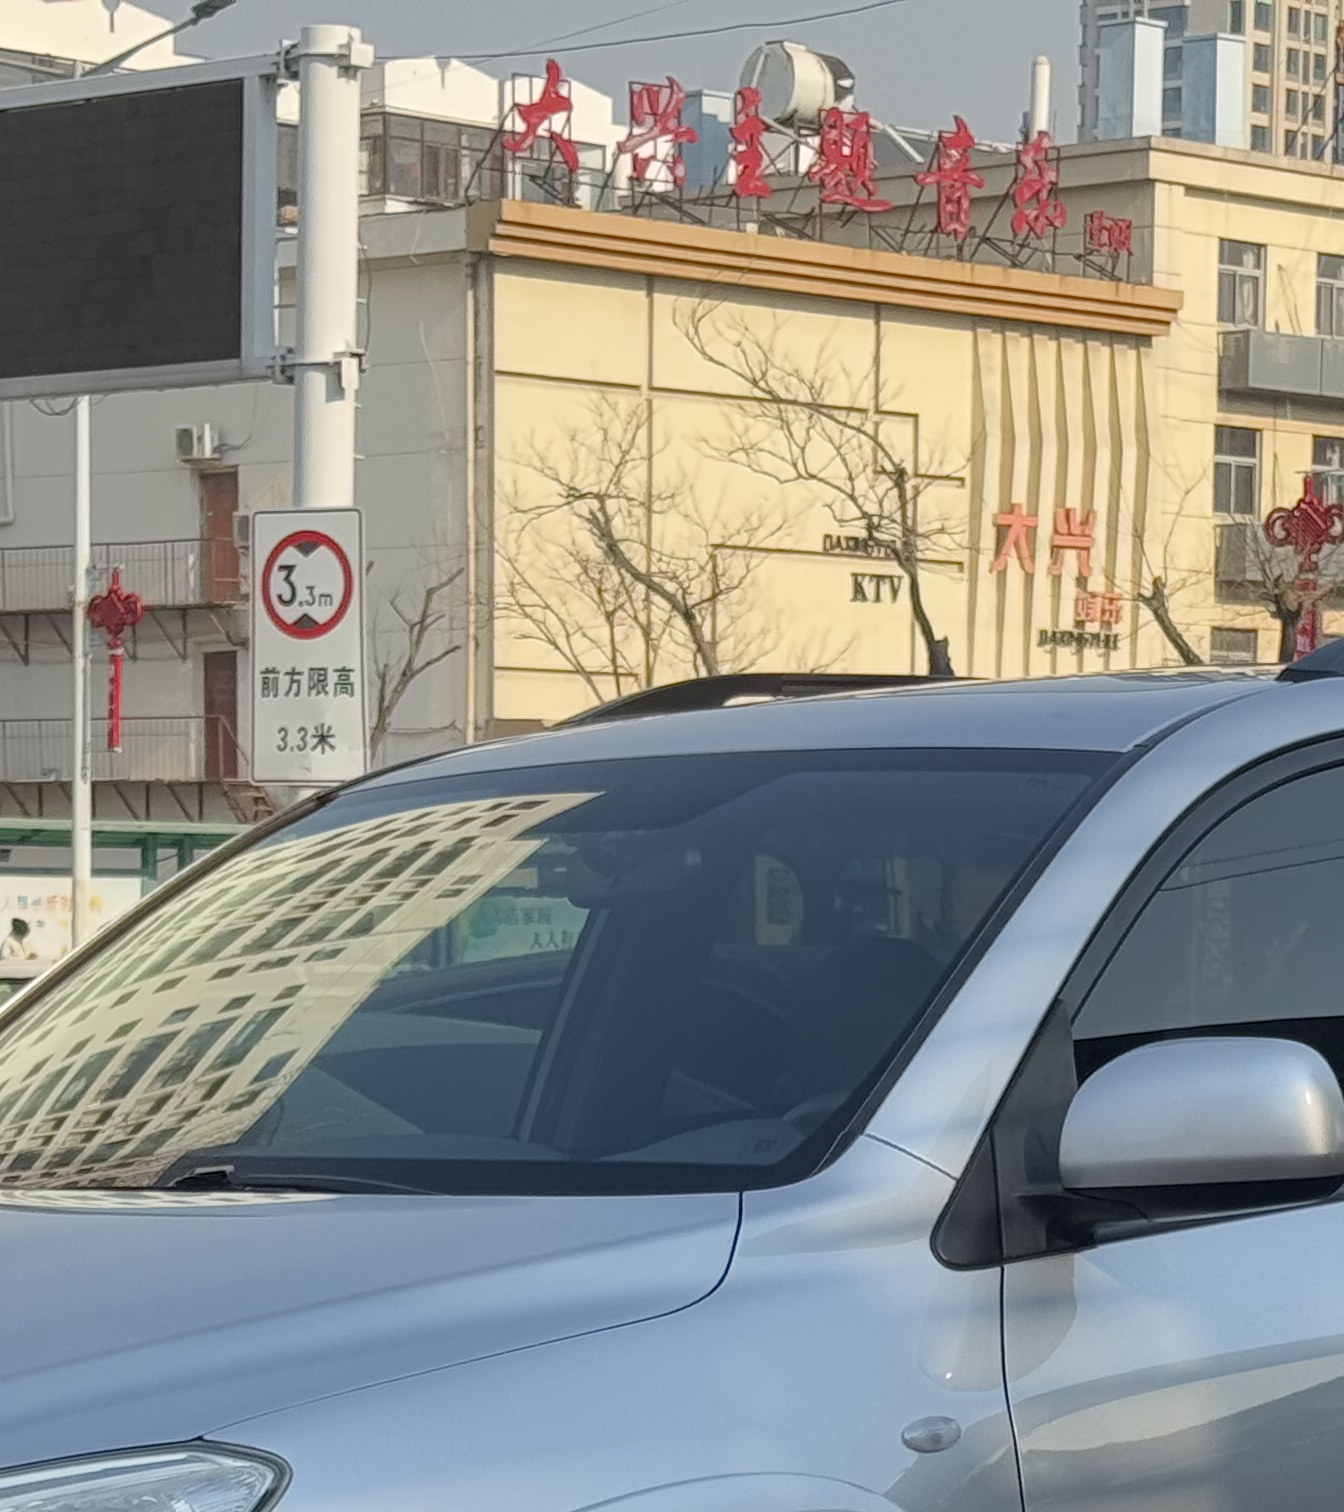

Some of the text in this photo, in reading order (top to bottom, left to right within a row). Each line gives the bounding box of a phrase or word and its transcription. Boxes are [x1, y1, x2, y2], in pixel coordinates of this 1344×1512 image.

[990, 504, 1096, 577] 大兴
[850, 572, 906, 605] KTV
[260, 666, 356, 699] 前方限高
[276, 722, 337, 755] 3.3米
